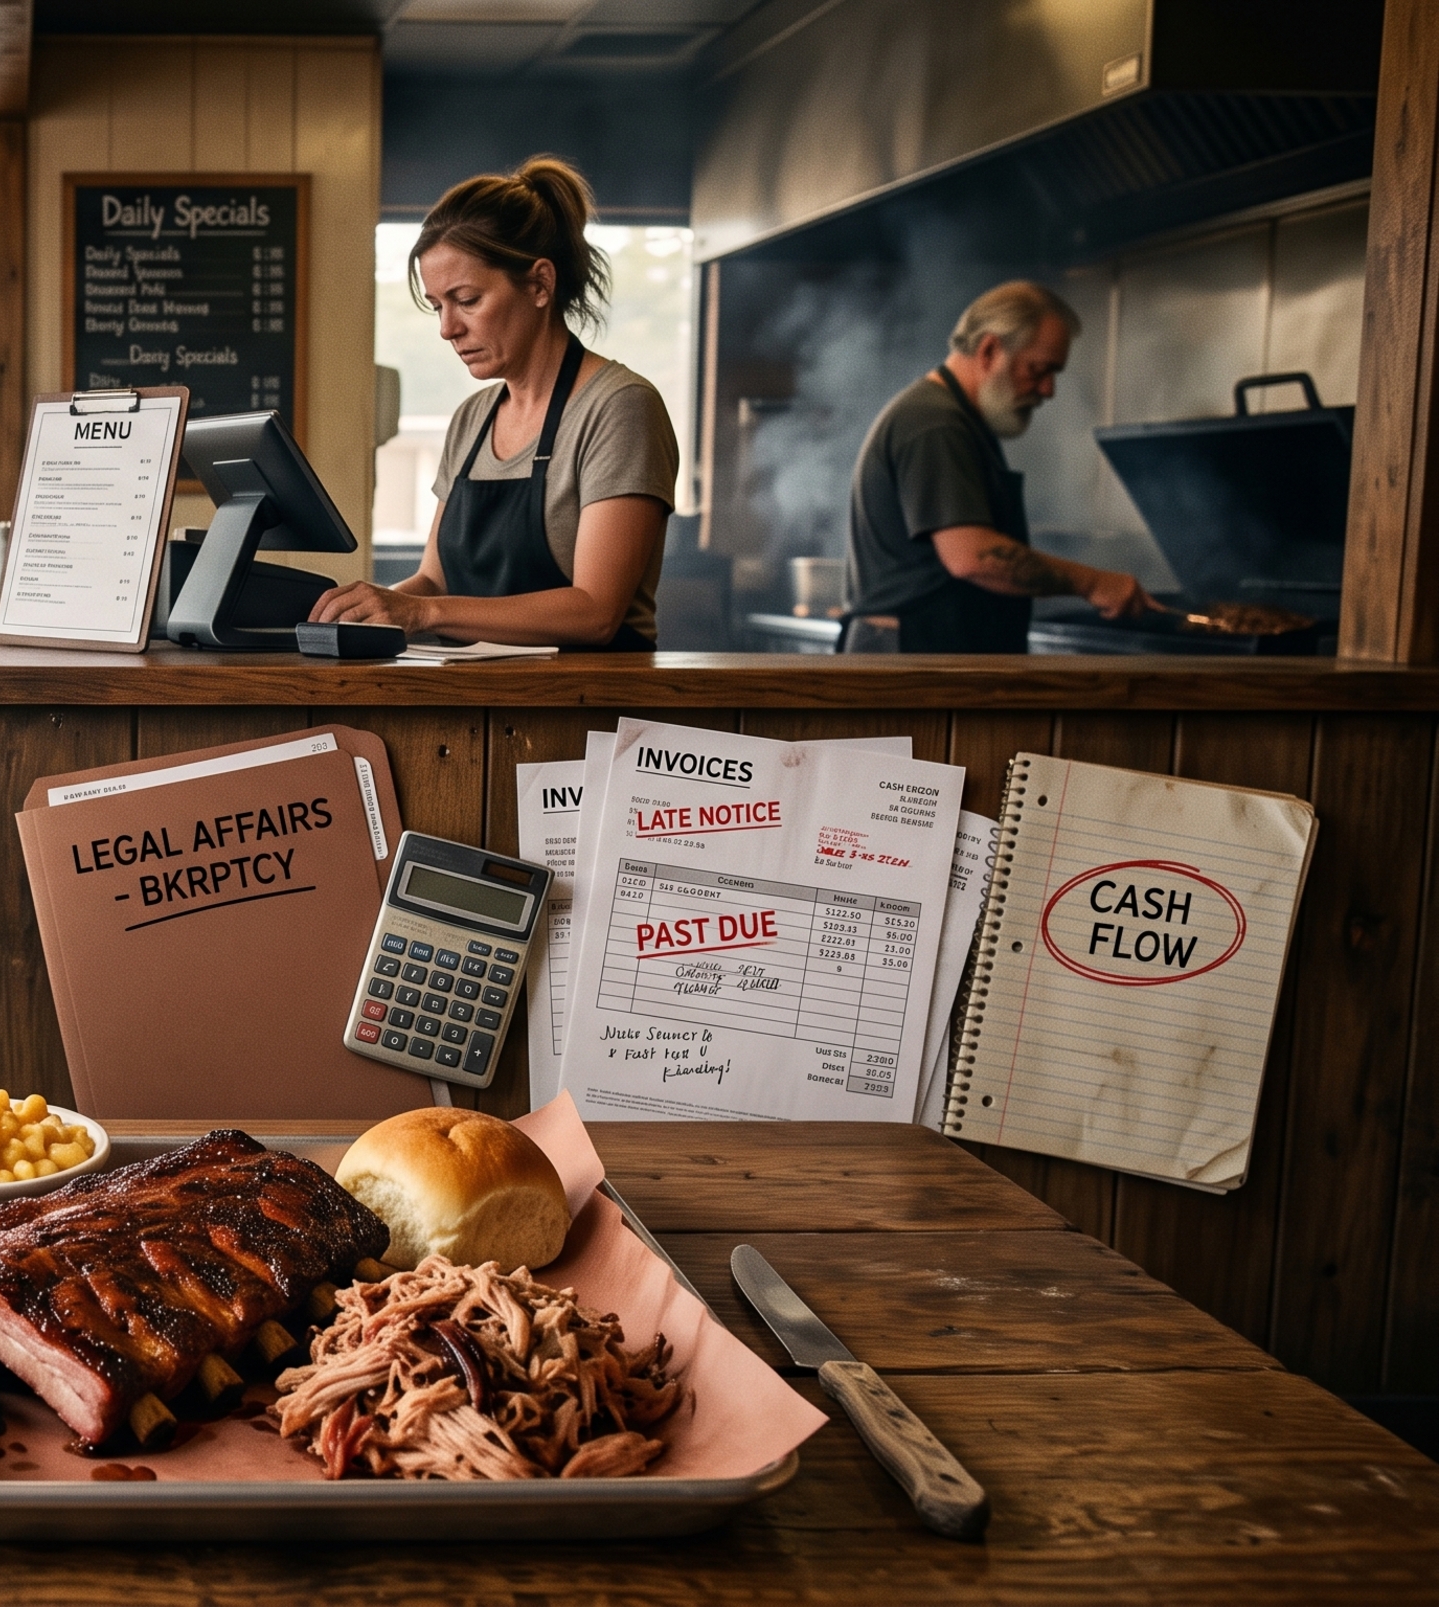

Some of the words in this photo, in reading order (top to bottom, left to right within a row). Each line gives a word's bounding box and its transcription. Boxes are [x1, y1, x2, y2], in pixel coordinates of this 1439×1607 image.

[103, 195, 164, 239] Daily
[174, 194, 270, 239] Specials
[74, 421, 132, 440] MENU
[637, 747, 753, 782] INVOICES
[542, 786, 583, 809] INV
[879, 781, 904, 792] CASH
[72, 827, 182, 874] LEGAL
[193, 797, 333, 852] AFFAIRS
[637, 808, 692, 831] LATE
[699, 801, 781, 826] NOTICE
[140, 848, 295, 906] BKRPTCY
[1090, 880, 1192, 925] CASH
[637, 918, 709, 951] PAST
[718, 910, 778, 942] DUE
[1089, 922, 1198, 969] FLOW
